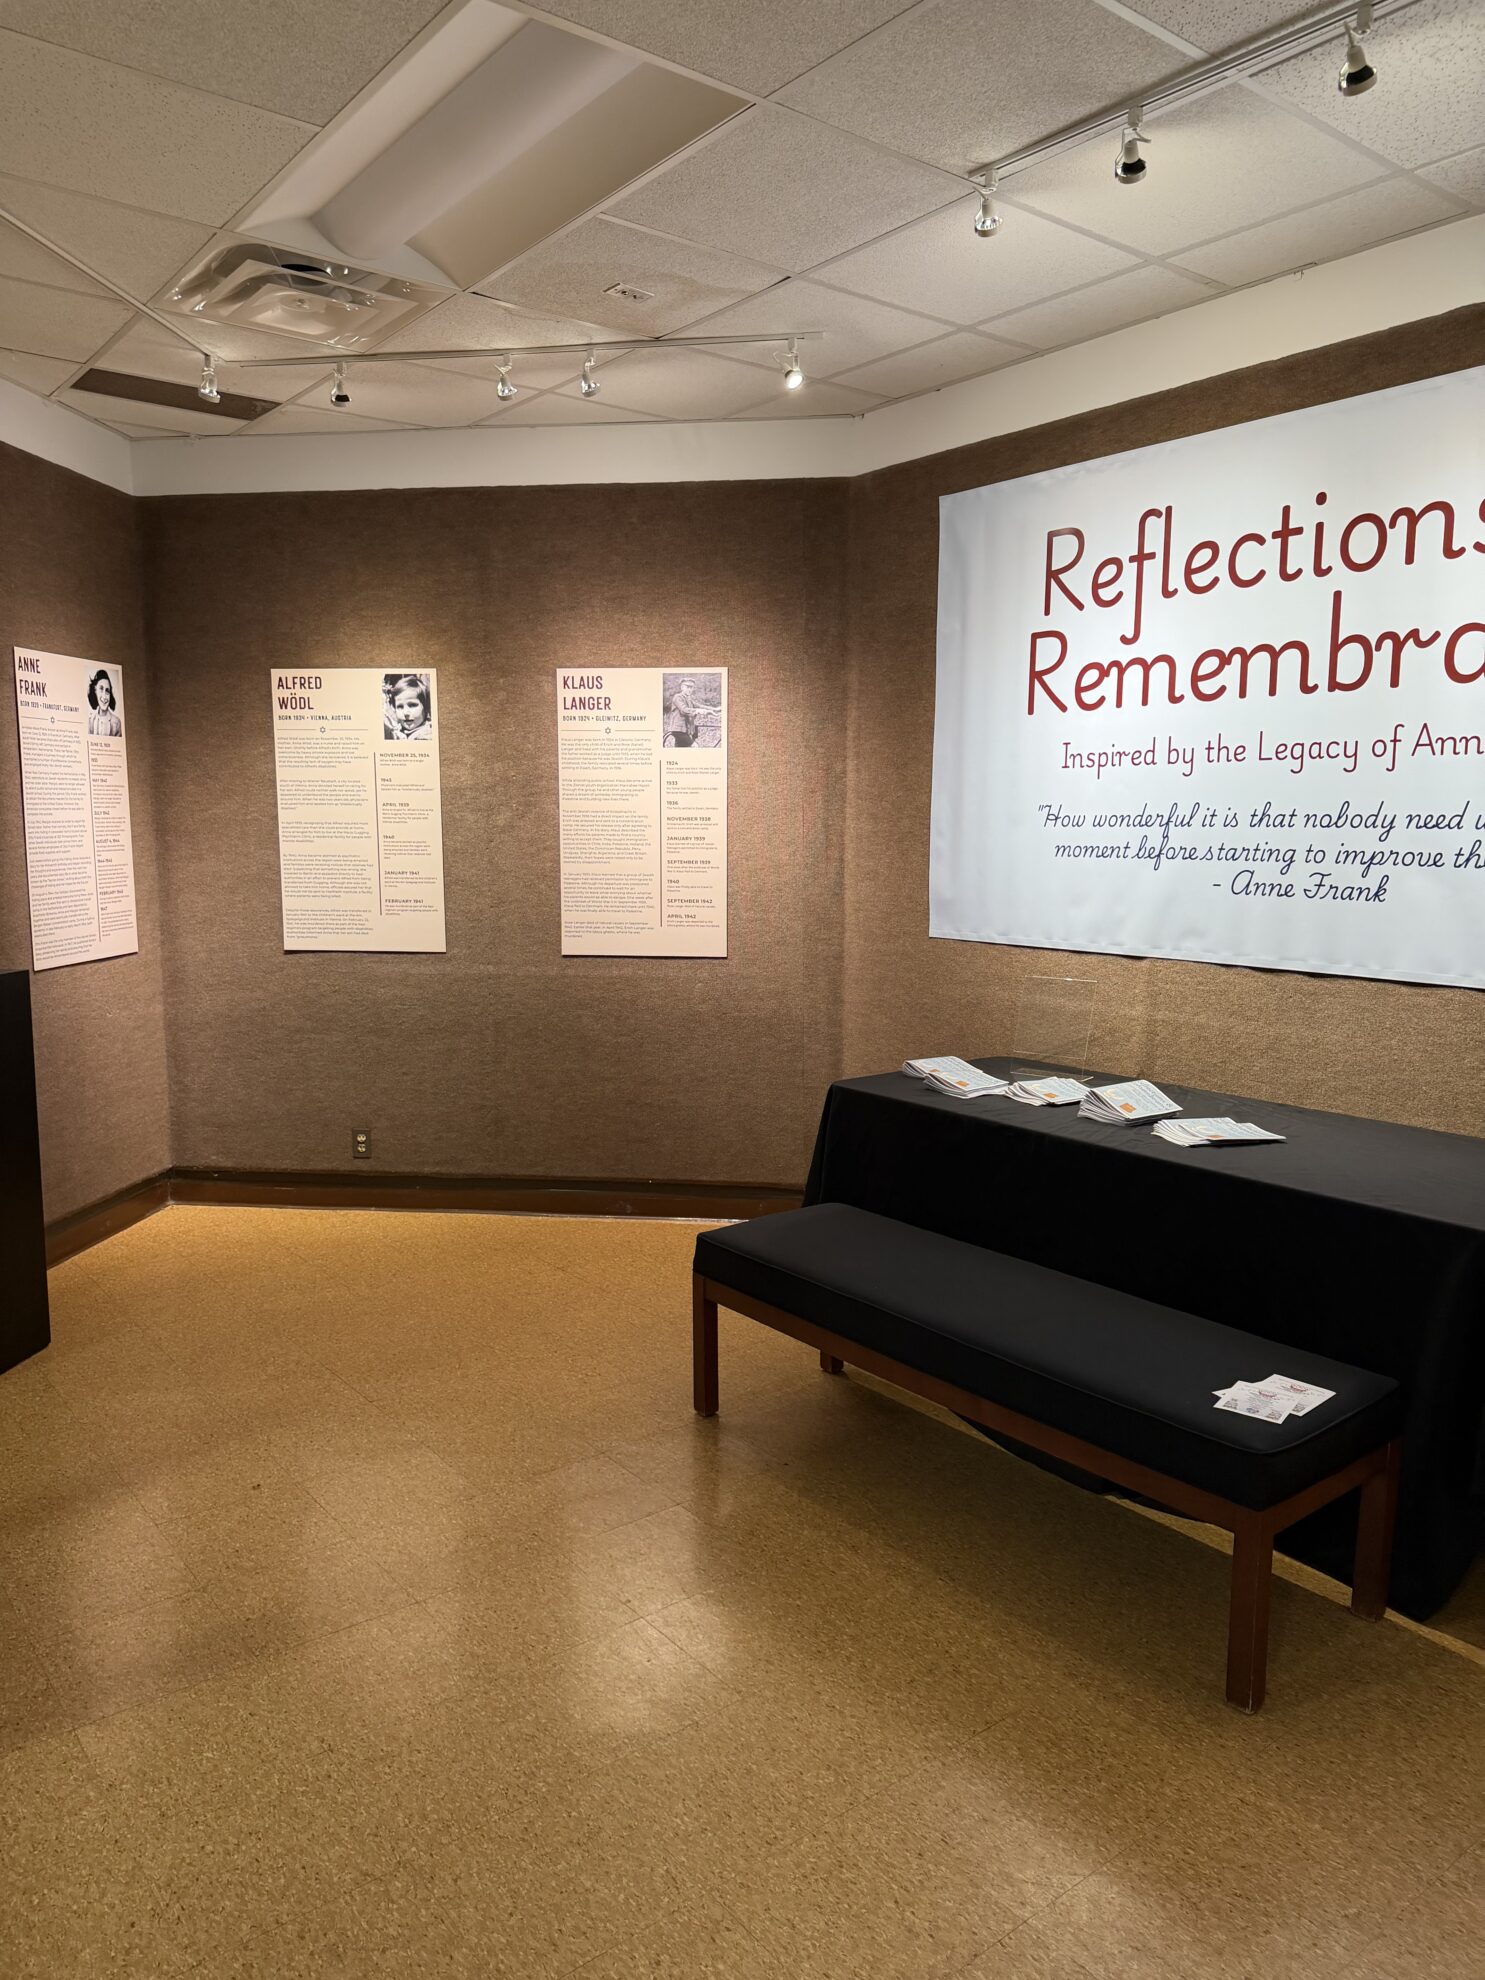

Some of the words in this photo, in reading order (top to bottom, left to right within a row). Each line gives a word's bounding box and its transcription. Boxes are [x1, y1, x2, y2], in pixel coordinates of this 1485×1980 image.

[18, 656, 41, 674] ANNE
[19, 679, 48, 698] FRANK
[277, 676, 322, 690] ALFRED
[563, 675, 603, 690] KLAUS
[277, 692, 315, 710] WÖDL
[563, 696, 611, 711] LANGER
[1061, 735, 1157, 779] Inspired
[1167, 735, 1195, 777] by
[1204, 732, 1247, 763] the
[1258, 730, 1358, 773] Legacy
[1371, 724, 1405, 772] of
[1092, 802, 1201, 838] wonderful
[1201, 806, 1218, 828] it
[1223, 806, 1239, 828] is
[1249, 801, 1298, 828] that
[1304, 800, 1397, 843] nobody
[1406, 800, 1470, 830] need
[1055, 841, 1131, 859] moment
[1131, 835, 1199, 870] before
[1198, 842, 1297, 876] starting
[1305, 844, 1326, 864] to
[1335, 843, 1446, 878] improve
[1454, 839, 1485, 870] th
[1231, 869, 1296, 898] Anne
[1303, 872, 1390, 903] Frank
